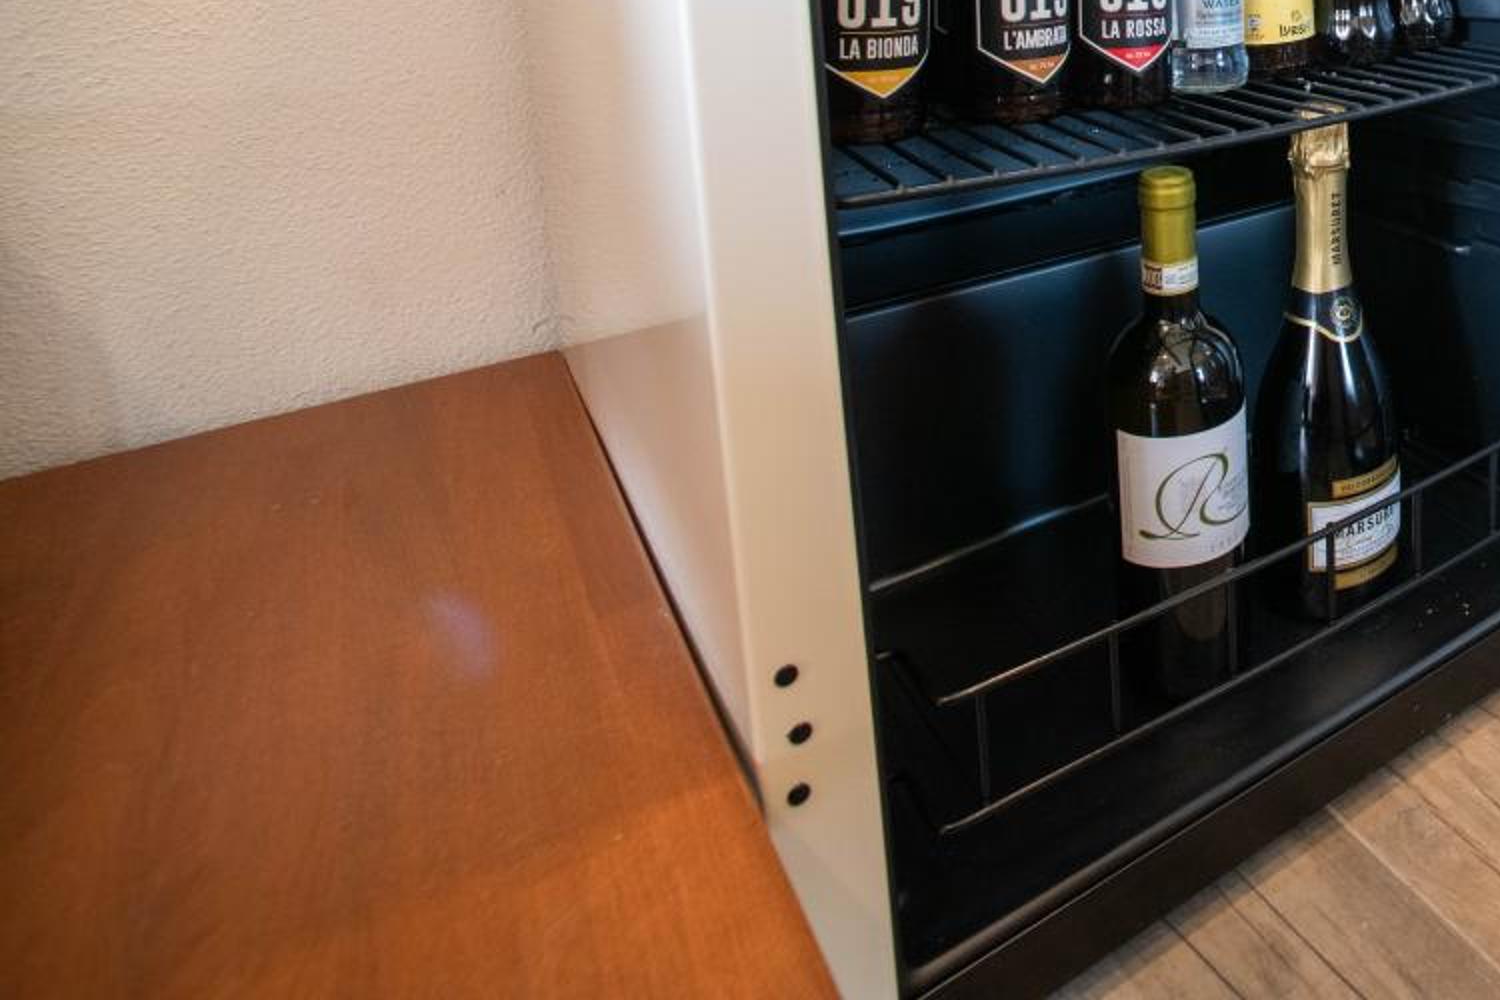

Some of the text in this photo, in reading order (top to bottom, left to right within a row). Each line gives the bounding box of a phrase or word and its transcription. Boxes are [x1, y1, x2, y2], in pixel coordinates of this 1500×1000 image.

[1101, 17, 1167, 39] LA ROSSA
[839, 35, 920, 59] LA BIONDA
